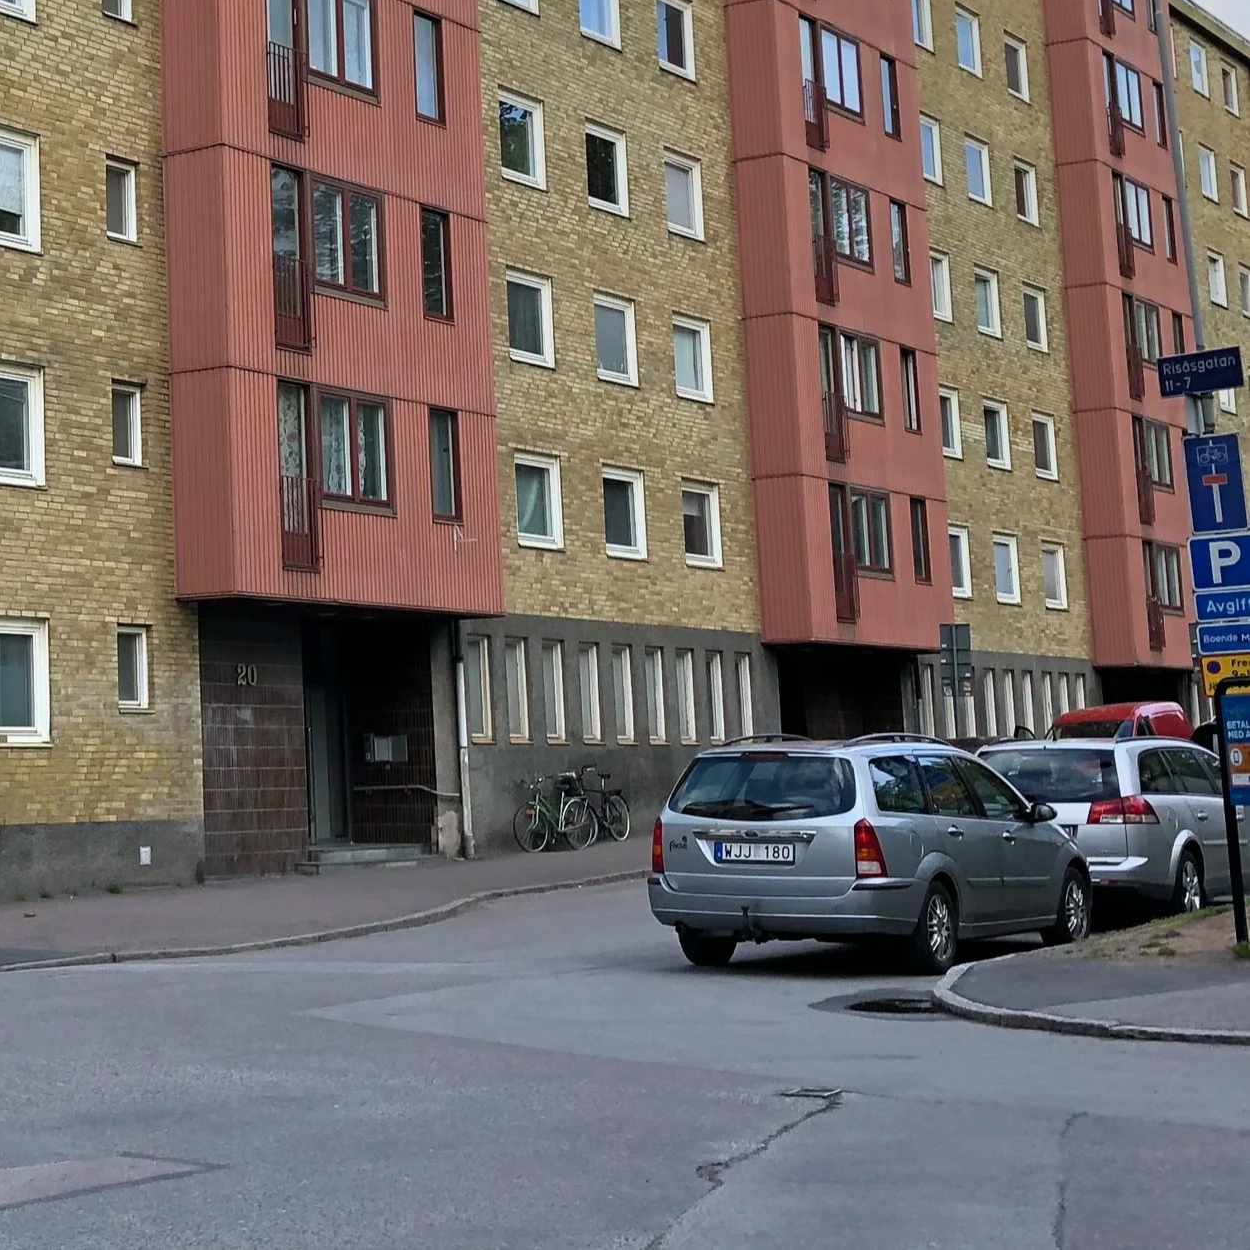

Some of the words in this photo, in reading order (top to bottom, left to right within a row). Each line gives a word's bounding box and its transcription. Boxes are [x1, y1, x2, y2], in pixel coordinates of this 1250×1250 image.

[1162, 356, 1236, 376] Risåsgatan
[1208, 540, 1241, 584] P
[1203, 634, 1238, 644] Boende
[237, 663, 257, 686] 20
[1227, 730, 1244, 739] MED
[724, 844, 752, 859] WJJ
[764, 845, 790, 860] 180
